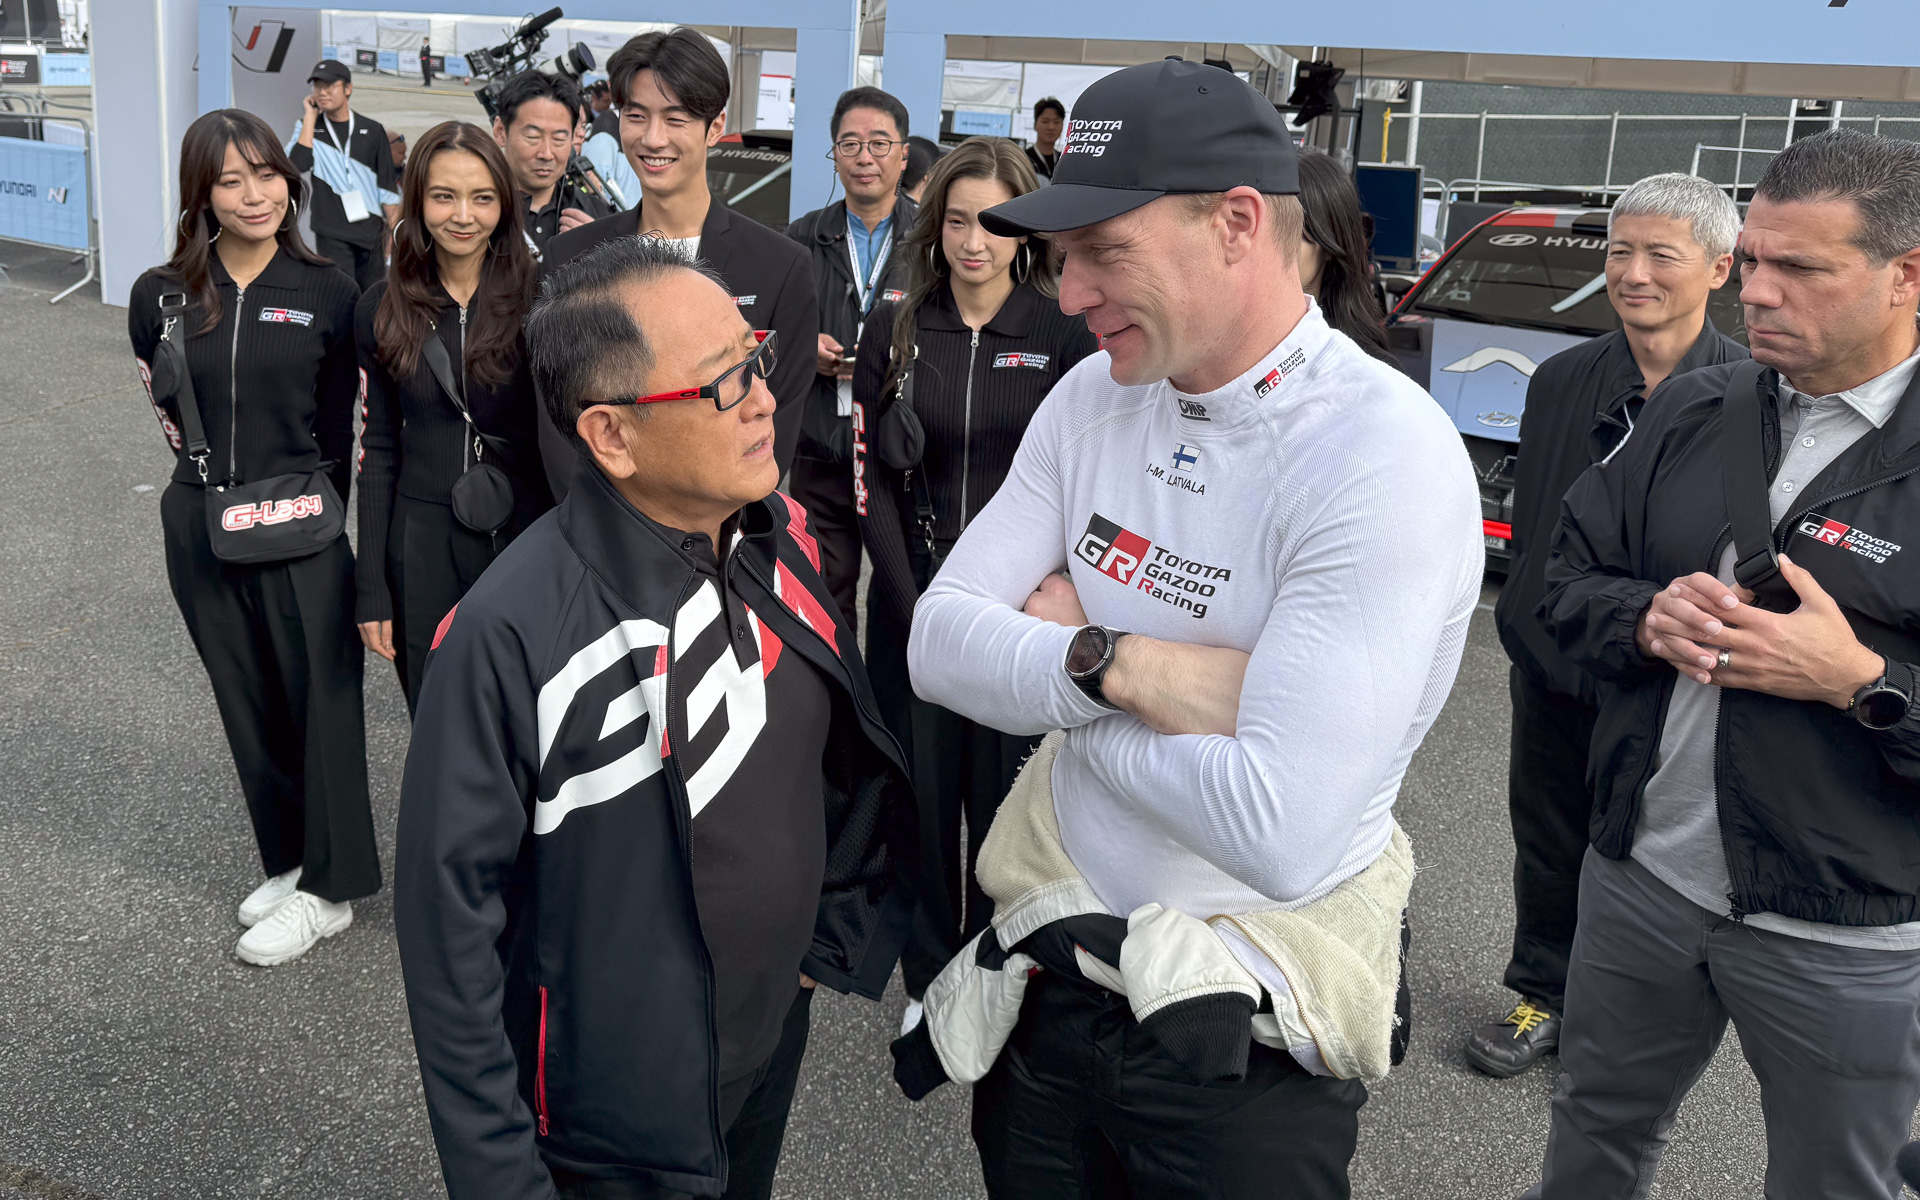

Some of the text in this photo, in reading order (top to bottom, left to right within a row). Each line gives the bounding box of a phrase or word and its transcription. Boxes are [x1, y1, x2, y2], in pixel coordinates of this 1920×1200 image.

[1070, 119, 1123, 131] TOYOTA
[1068, 132, 1113, 143] GAZOO
[722, 149, 790, 163] HYUNDAI
[0, 180, 37, 198] YUNDAI
[261, 309, 286, 322] GR
[995, 355, 1019, 367] GR
[1021, 353, 1050, 361] TOYOTA
[1277, 347, 1303, 369] TOYOTA
[1281, 352, 1304, 374] GAZOO
[1255, 372, 1282, 399] GR
[1178, 398, 1207, 417] OMP
[1166, 474, 1206, 496] LATVALA
[1798, 519, 1842, 544] GR
[1851, 528, 1902, 552] TOYOTA
[1076, 528, 1142, 584] GR
[1839, 541, 1887, 564] Racing
[1843, 535, 1893, 557] GAZOO
[1154, 545, 1232, 582] TOYOTA
[1144, 563, 1216, 598] GAZOO
[1136, 577, 1208, 619] Racing
